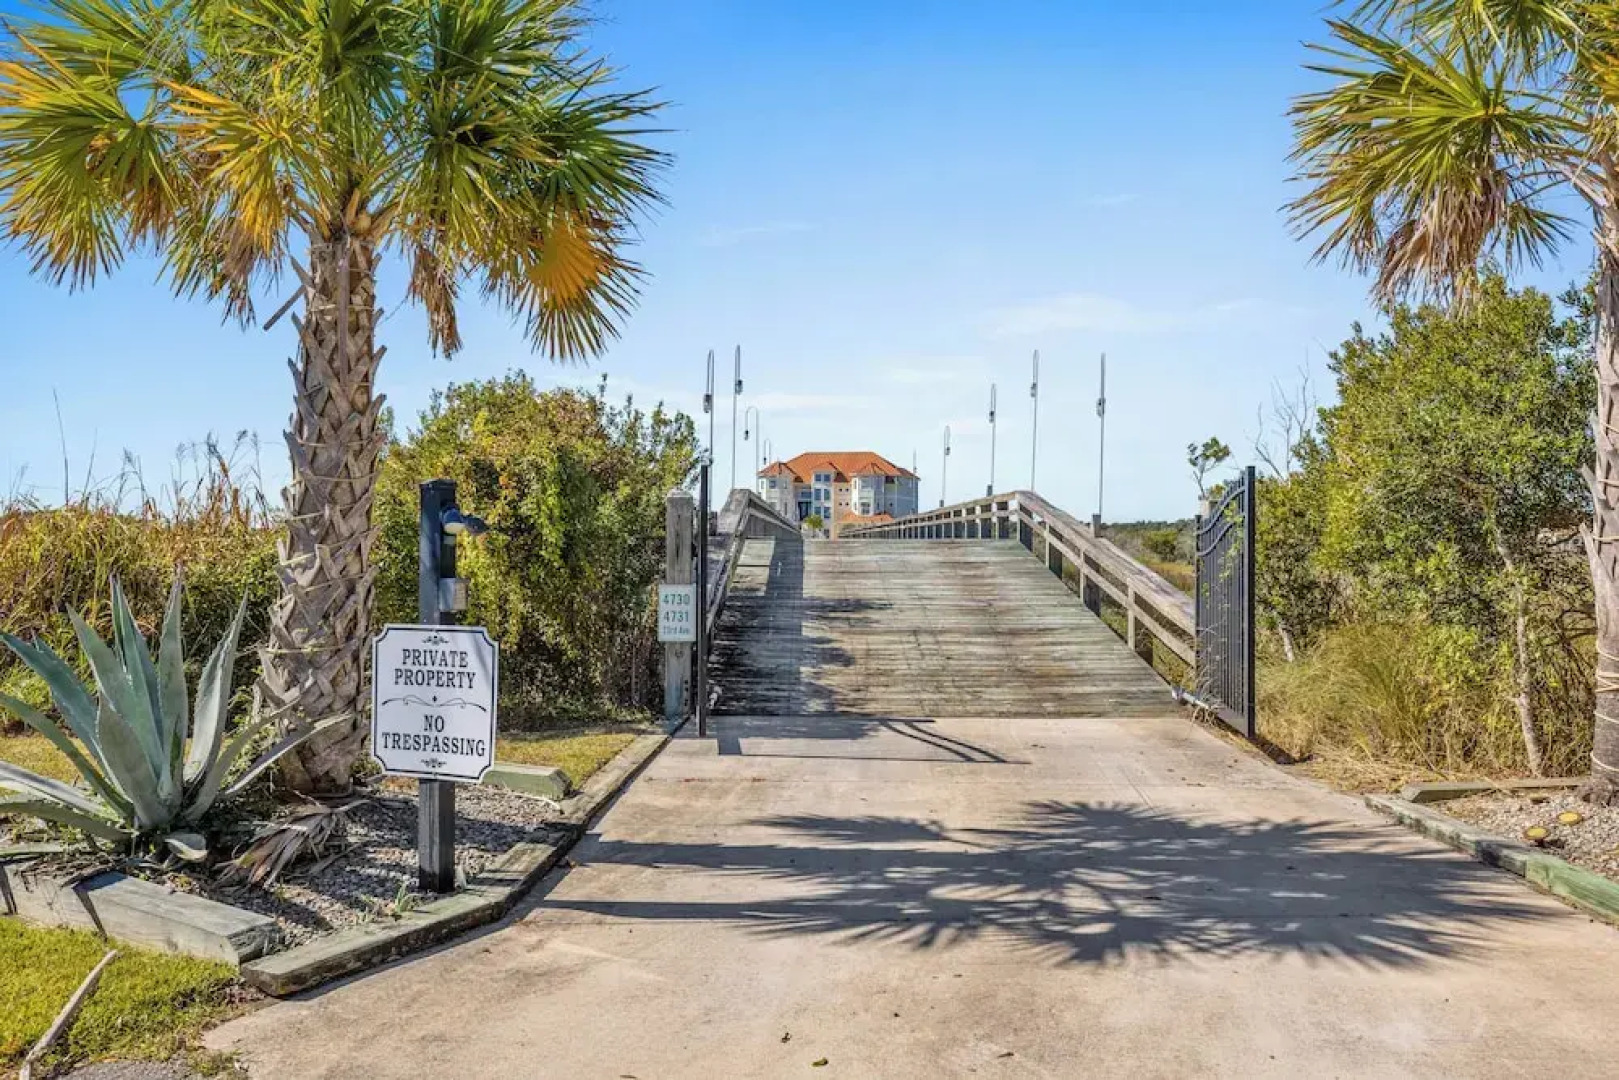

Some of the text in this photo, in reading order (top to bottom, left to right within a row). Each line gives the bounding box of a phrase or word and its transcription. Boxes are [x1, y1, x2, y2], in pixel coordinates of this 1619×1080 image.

[662, 593, 690, 605] 4730
[663, 611, 689, 622] 4731
[402, 649, 468, 668] PRIVATE
[394, 669, 476, 688] PROPERTY
[423, 714, 445, 732] NO
[382, 732, 486, 756] TRESPASSING
